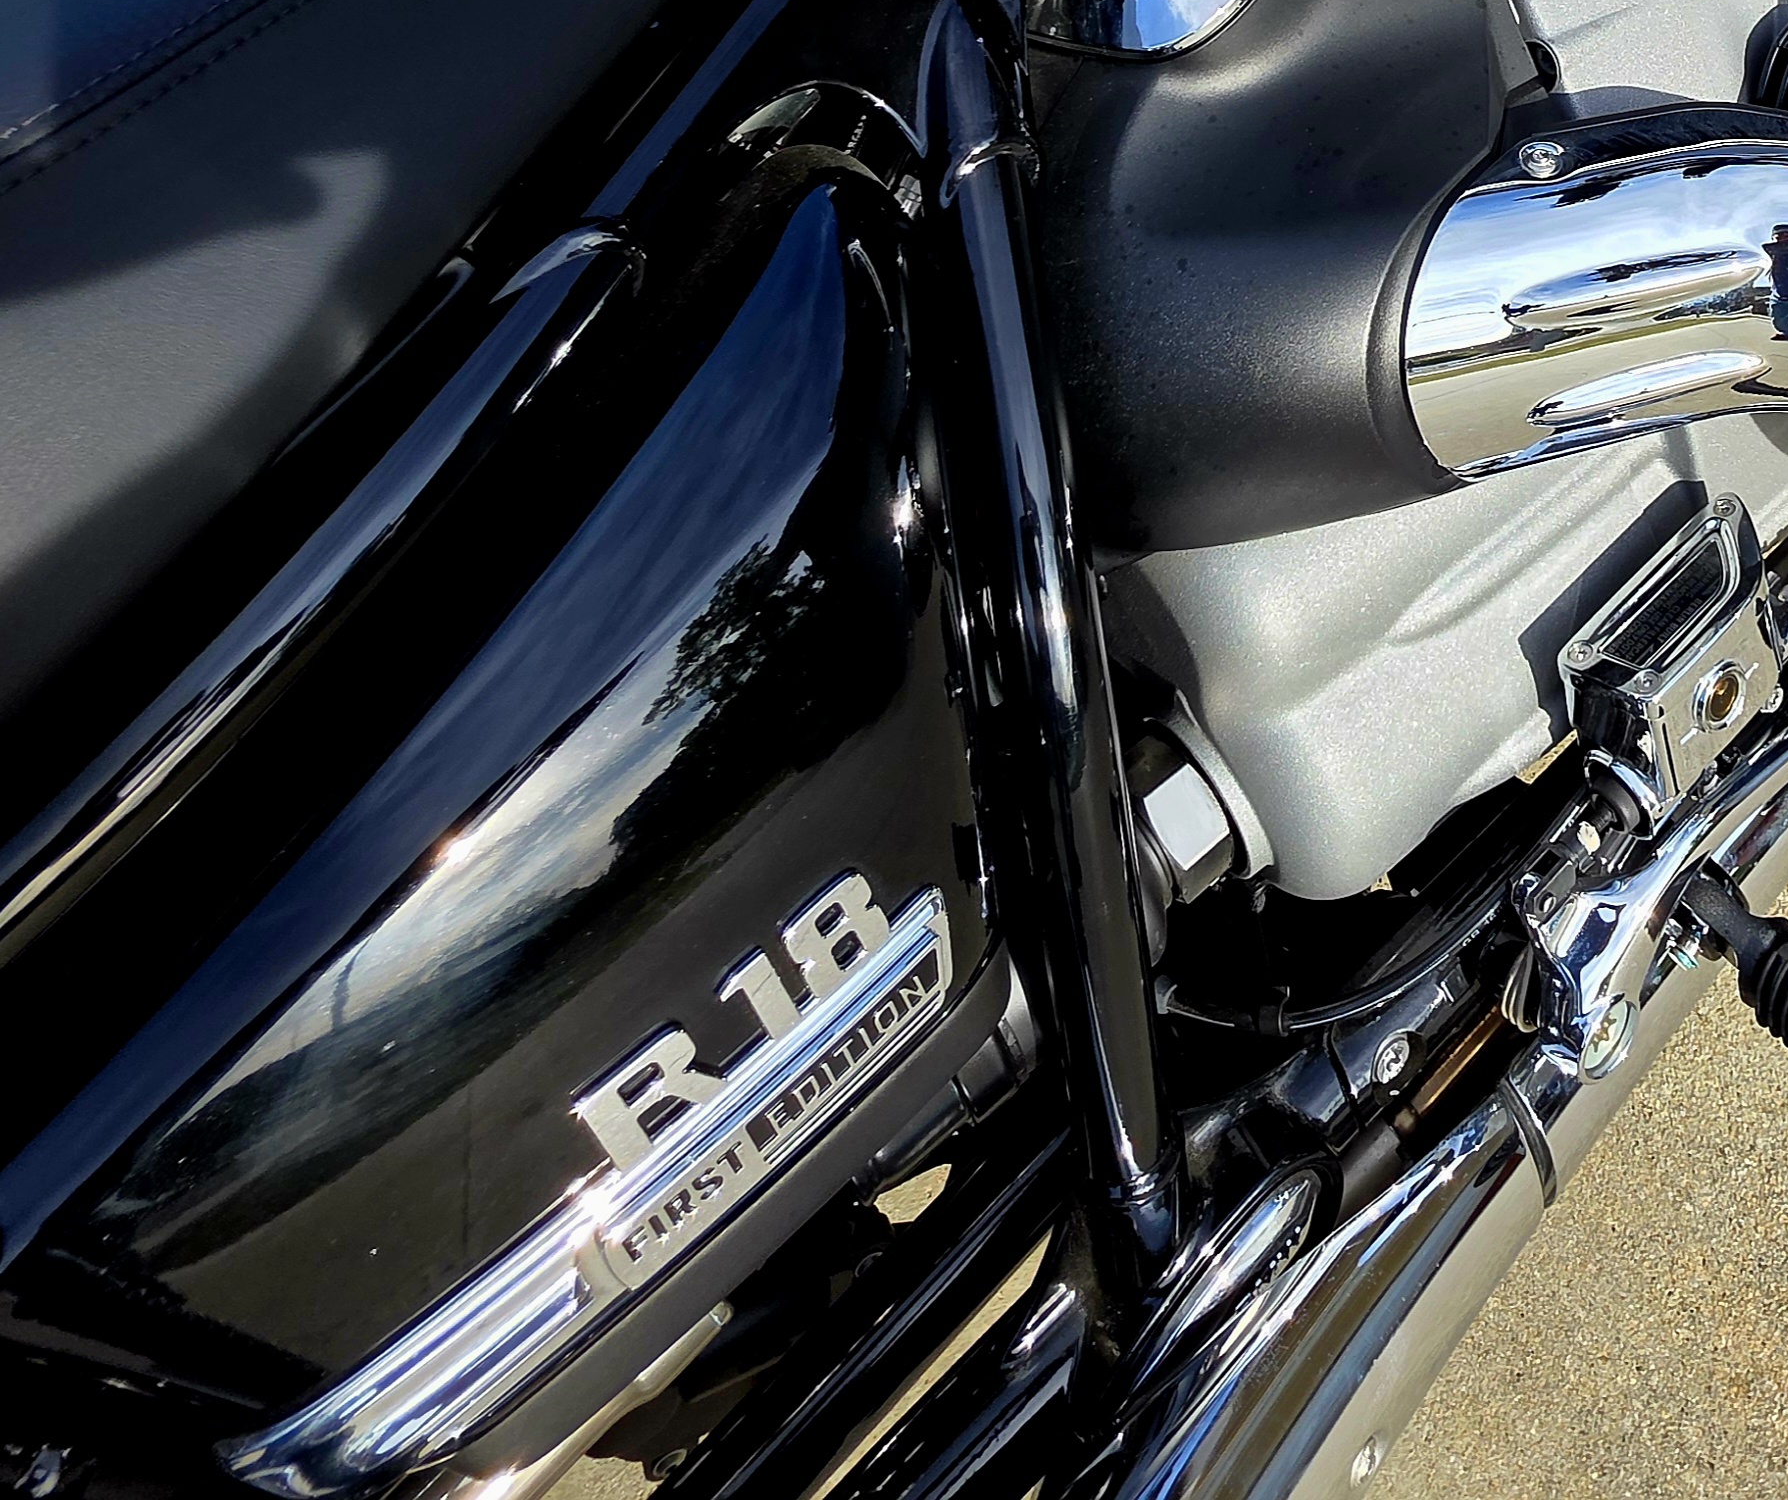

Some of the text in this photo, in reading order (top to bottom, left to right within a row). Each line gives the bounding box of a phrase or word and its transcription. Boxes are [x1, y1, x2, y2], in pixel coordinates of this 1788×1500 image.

[1675, 598, 1703, 623] BERLIN
[1656, 622, 1679, 644] BUILT
[621, 974, 928, 1264] FIRST EDITION
